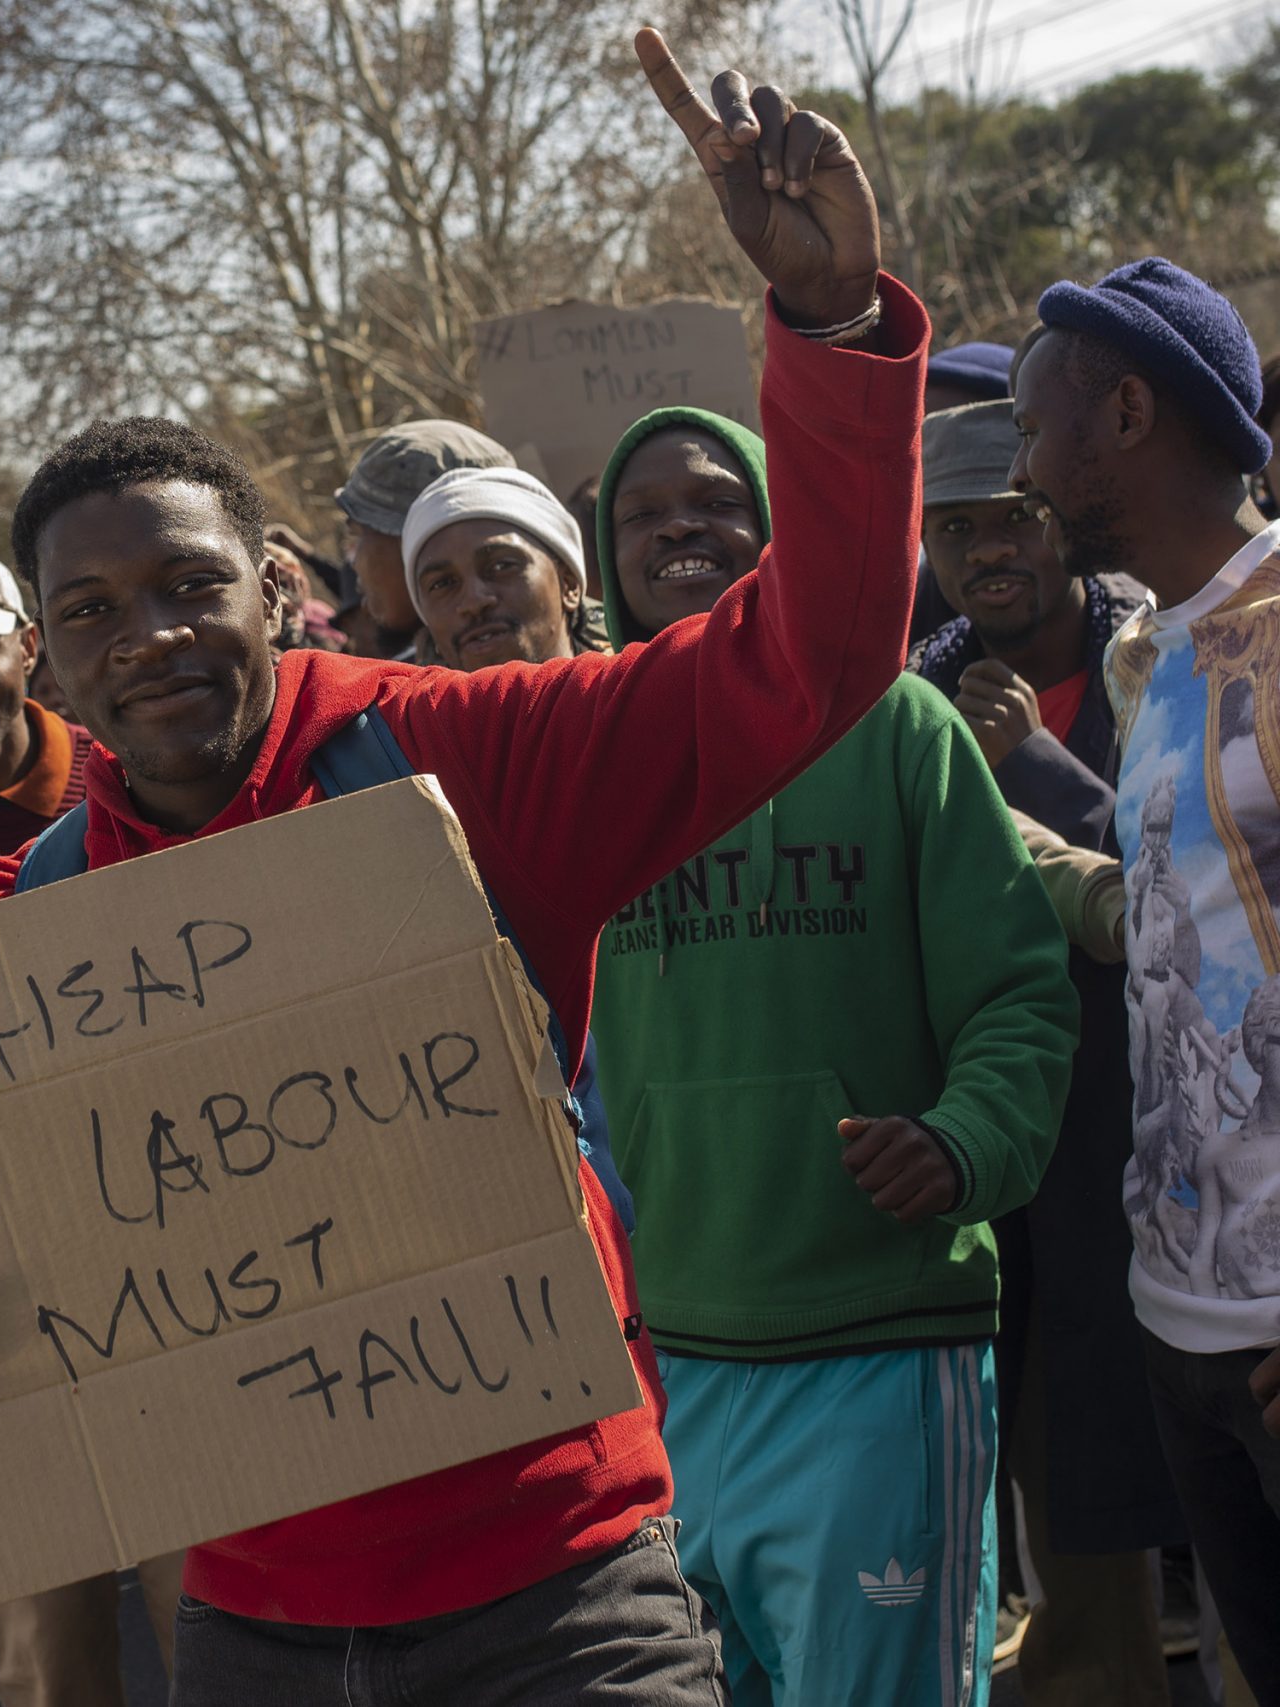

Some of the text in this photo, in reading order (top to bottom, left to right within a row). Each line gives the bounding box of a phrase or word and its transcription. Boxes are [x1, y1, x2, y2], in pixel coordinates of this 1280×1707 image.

[582, 364, 693, 404] MUST
[664, 914, 736, 947] WEAR
[749, 907, 867, 938] DIVISION
[91, 1032, 500, 1229] LABOUR
[37, 1218, 334, 1384] MUST
